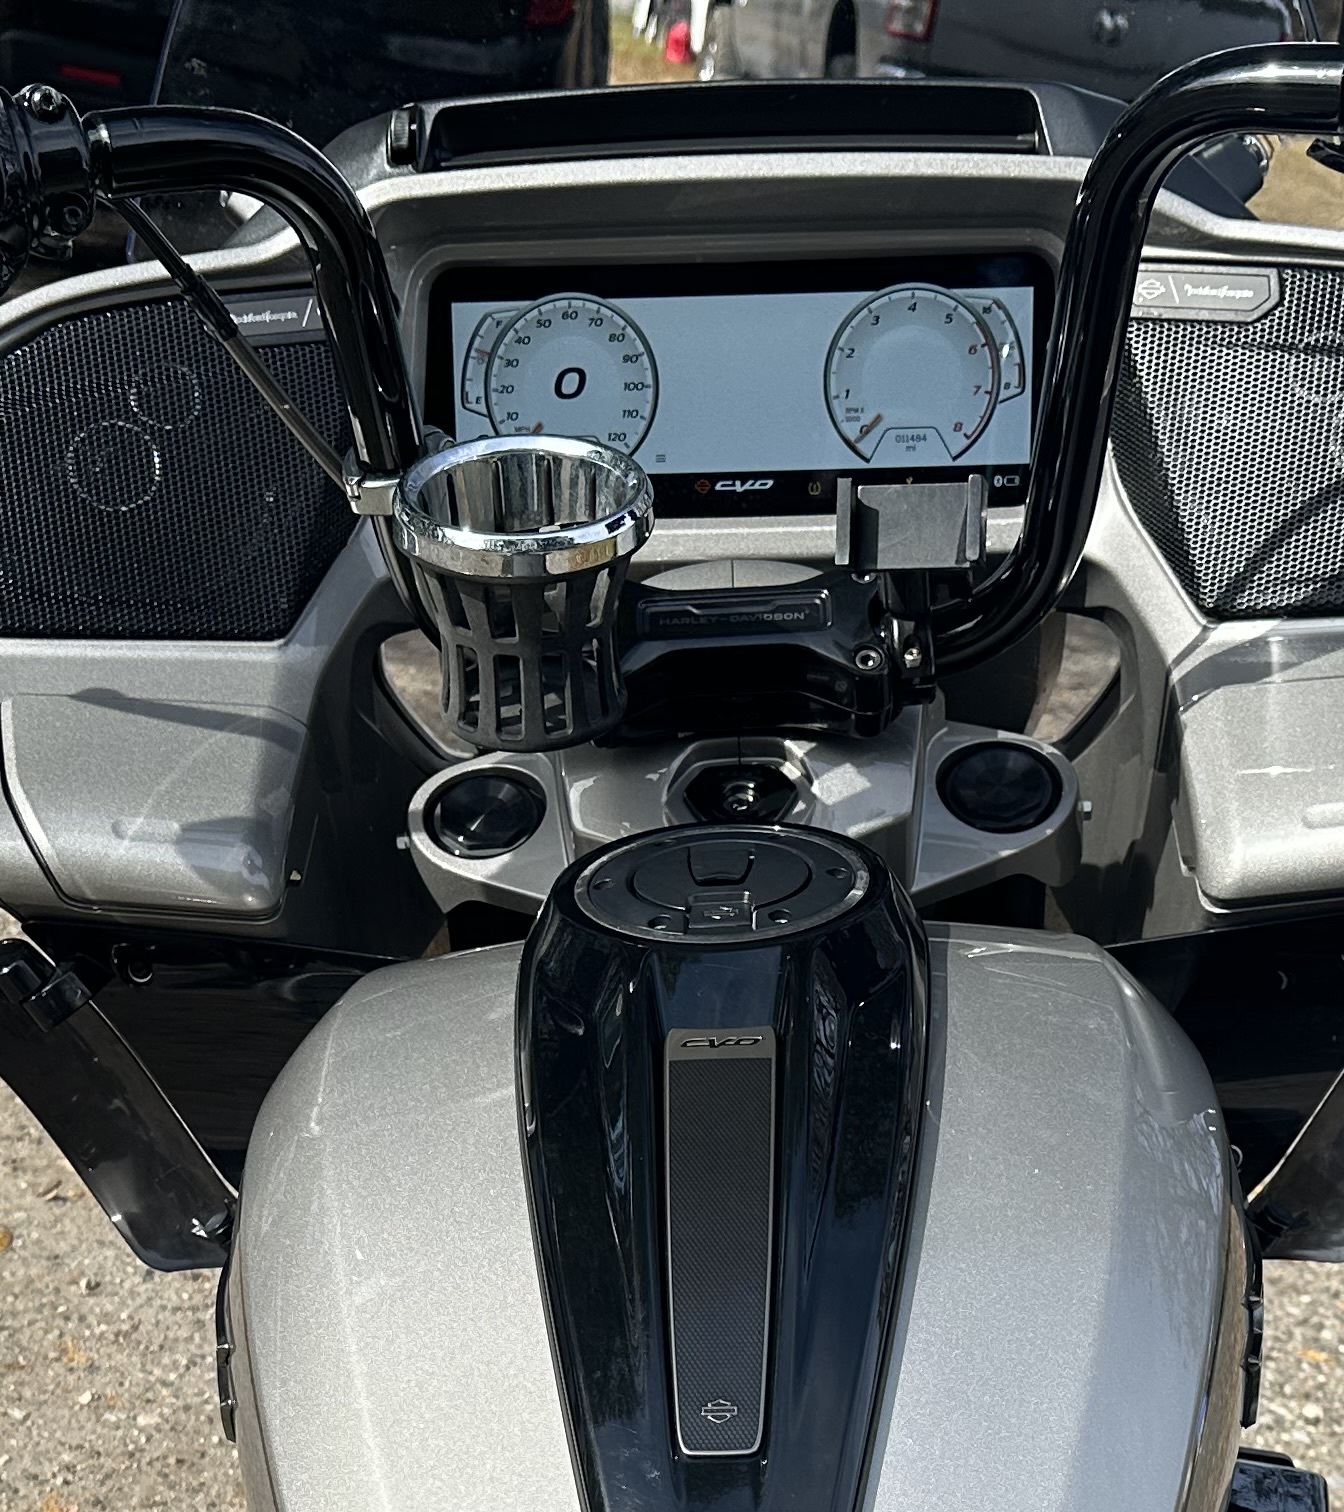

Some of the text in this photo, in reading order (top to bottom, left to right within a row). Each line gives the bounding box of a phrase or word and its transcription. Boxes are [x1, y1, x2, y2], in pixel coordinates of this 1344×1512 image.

[908, 301, 918, 312] 4
[561, 310, 579, 320] 60
[871, 315, 880, 325] 3
[944, 313, 954, 324] 5
[535, 318, 552, 329] 50
[588, 317, 603, 328] 70
[514, 335, 531, 346] 40
[608, 332, 625, 343] 80
[845, 348, 855, 358] 2
[968, 344, 978, 355] 6
[505, 358, 519, 368] 30
[622, 354, 639, 364] 90
[554, 366, 587, 400] 0
[623, 381, 644, 391] 100
[498, 385, 514, 395] 20
[845, 389, 851, 399] 1
[973, 385, 981, 395] 7
[506, 411, 519, 421] 10
[622, 409, 639, 419] 110
[953, 422, 963, 432] 8
[608, 432, 627, 442] 120
